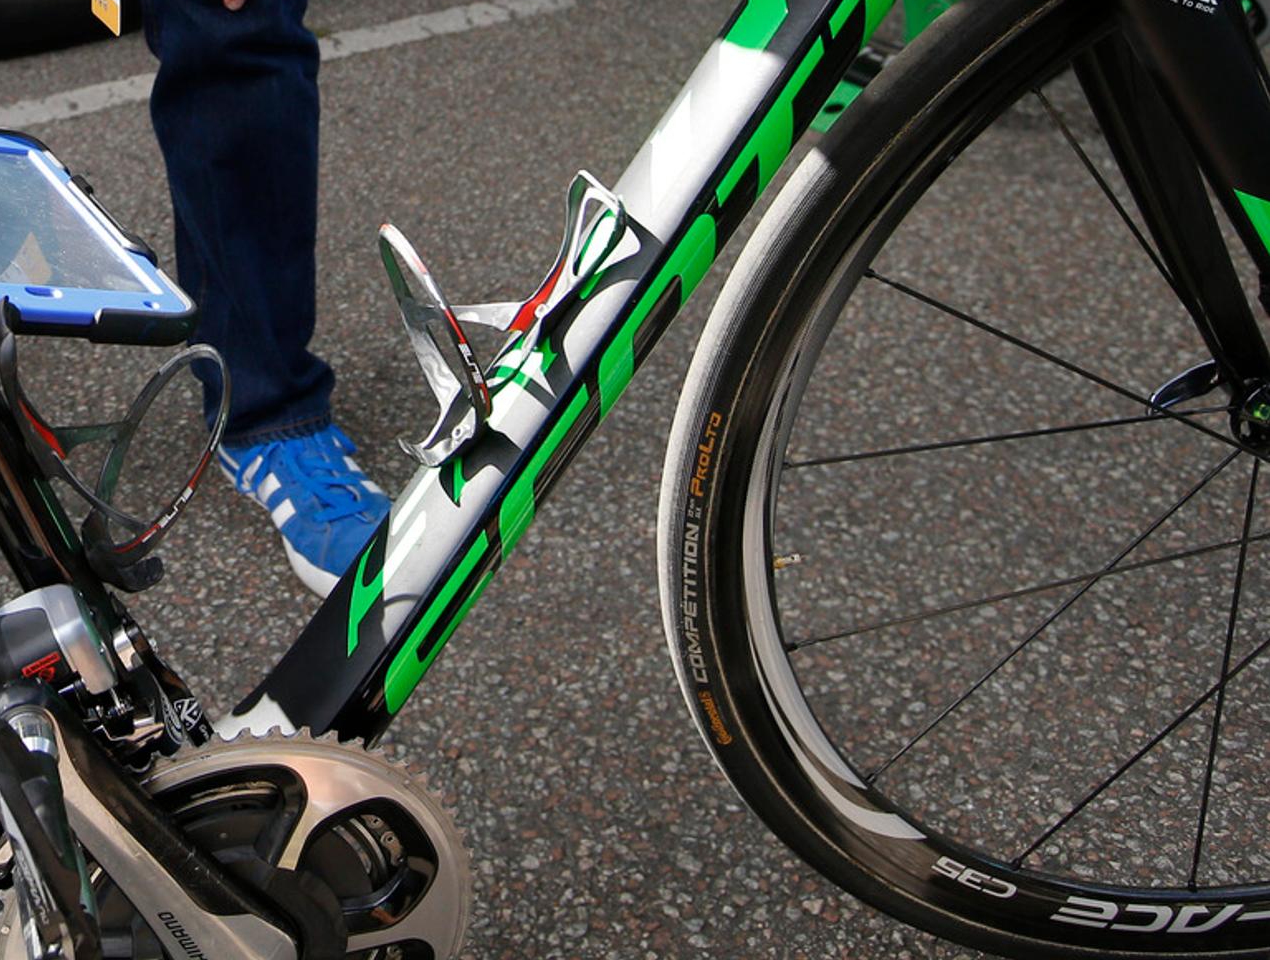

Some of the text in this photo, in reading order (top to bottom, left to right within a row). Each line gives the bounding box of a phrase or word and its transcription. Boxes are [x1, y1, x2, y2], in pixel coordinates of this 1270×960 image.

[1195, 1, 1216, 14] RIDE
[681, 522, 708, 683] COMPETITION
[931, 855, 1017, 898] C35
